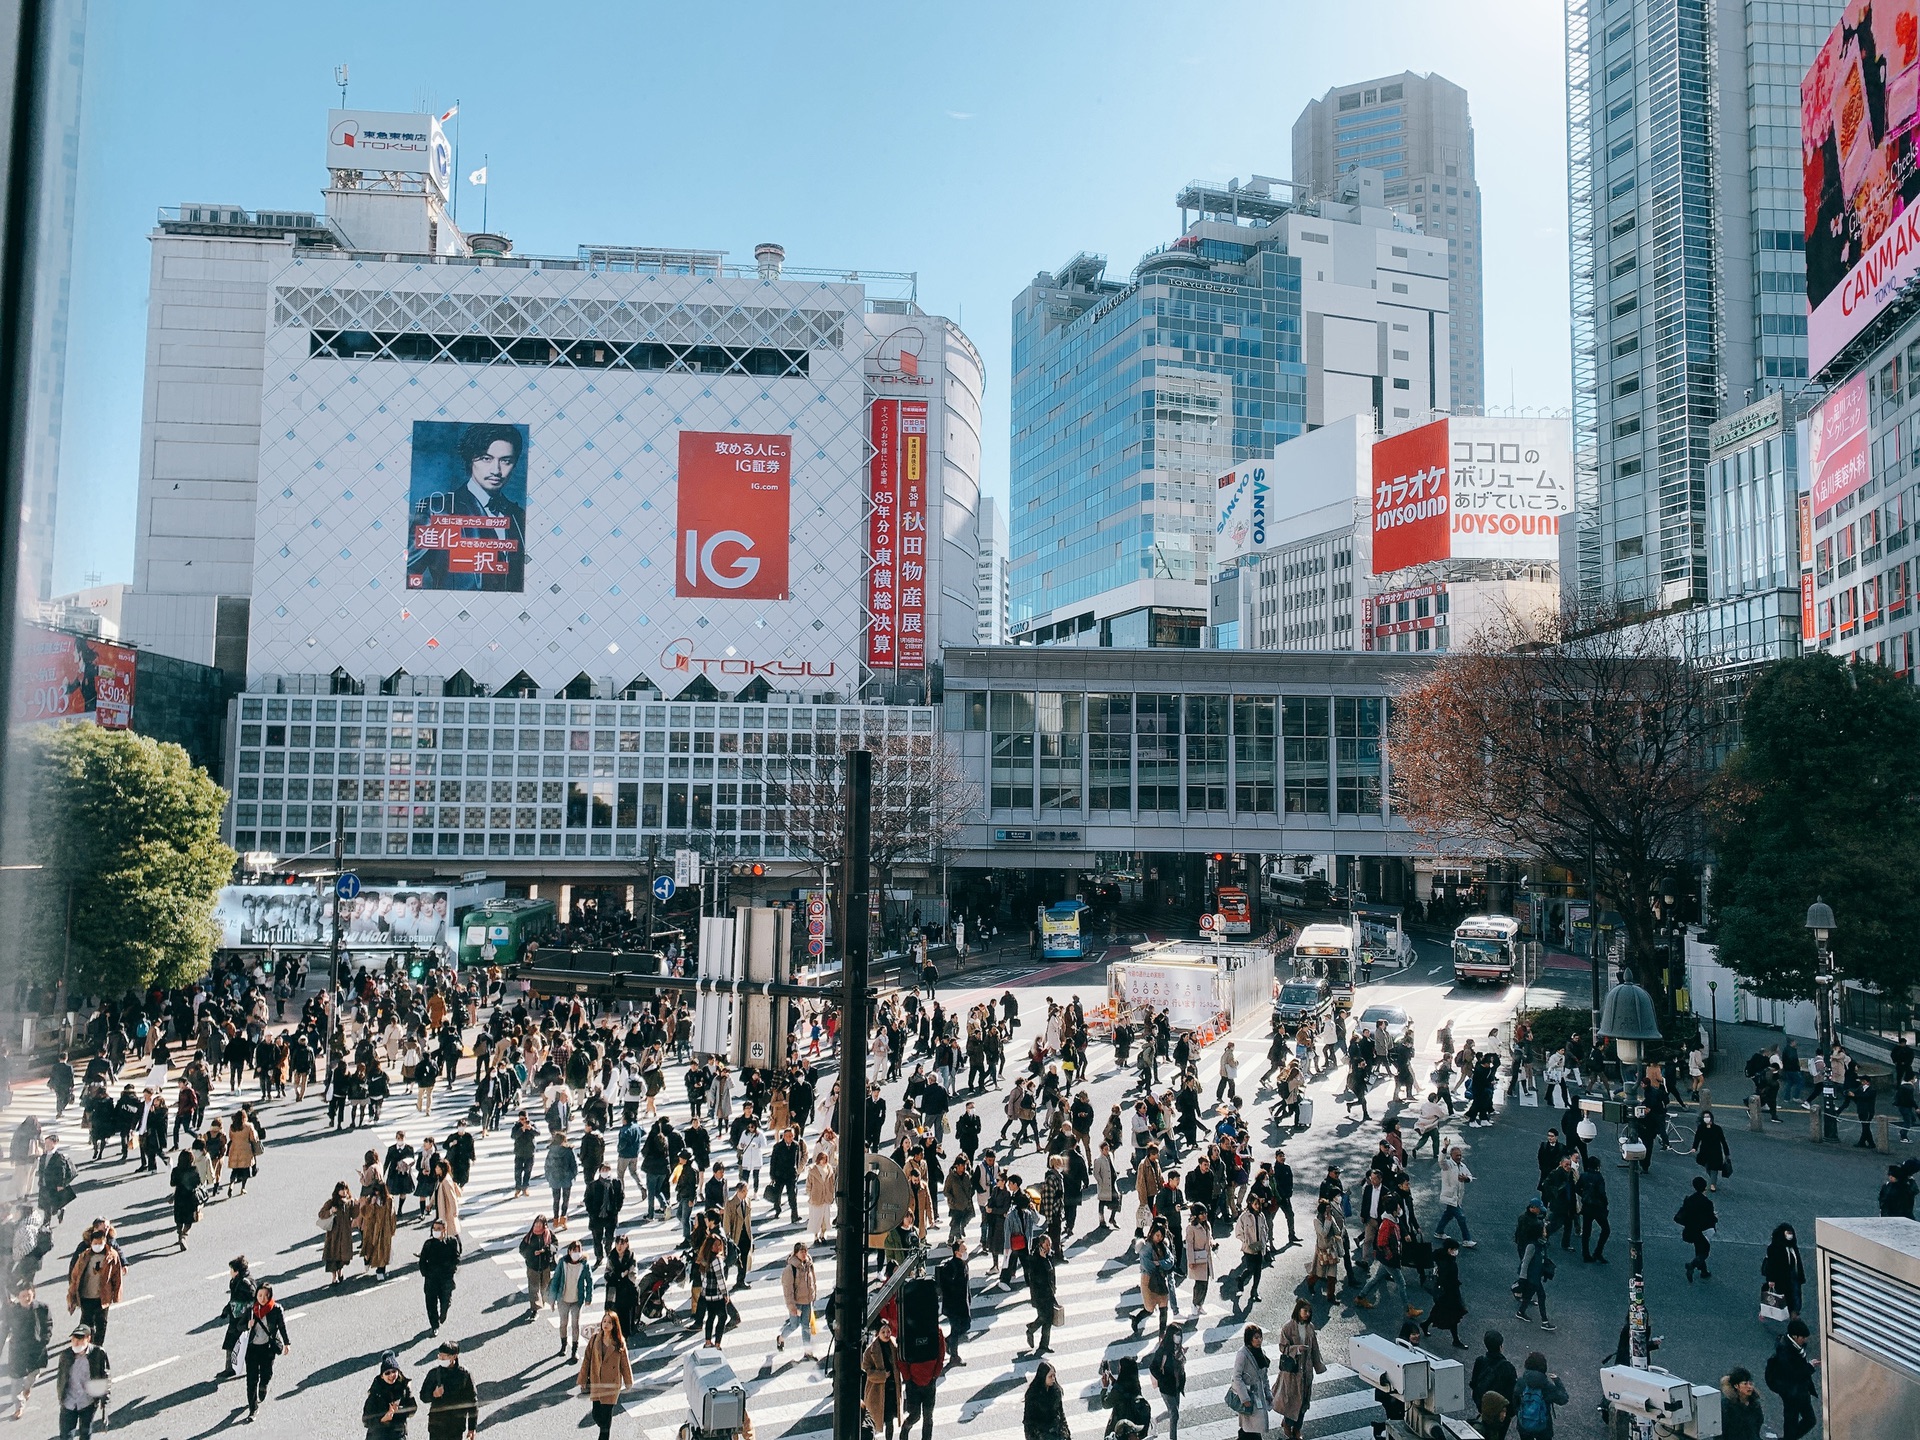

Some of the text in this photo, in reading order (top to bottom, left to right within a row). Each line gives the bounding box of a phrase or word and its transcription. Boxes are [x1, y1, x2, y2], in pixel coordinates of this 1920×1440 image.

[358, 141, 427, 151] TOKYU
[363, 131, 426, 141] 東急東横店
[1168, 278, 1239, 294] TOKYU PLAZA
[1874, 275, 1897, 306] TOKYO
[1097, 284, 1138, 319] FUKURAS
[867, 375, 933, 385] TOKYU
[1834, 386, 1864, 419] 品川スキン
[1834, 408, 1860, 440] クリニック
[715, 442, 786, 457] 攻める人に。
[1454, 442, 1539, 464] ココロの
[736, 460, 780, 473] IG証券
[1820, 451, 1865, 500] 品川美容外科
[1376, 465, 1446, 510] カラオケ
[1454, 466, 1565, 490] ボリューム、
[415, 491, 455, 514] #01
[1217, 473, 1249, 535] SANKYO
[1254, 468, 1270, 544] SANKYO
[1454, 492, 1568, 511] あげていこう。
[434, 517, 507, 526] 人生に迷ったら、自分が
[1376, 495, 1448, 532] JOYSOUND
[418, 528, 515, 549] 進化できるかどうかの、
[453, 552, 506, 572] 一択で。
[685, 530, 760, 589] IG
[410, 578, 421, 586] IG
[902, 511, 925, 633] 秋田物産展
[1379, 593, 1402, 604] カラオケ
[1403, 586, 1432, 599] JOYSOUND
[691, 659, 835, 676] TOKYU
[1608, 1391, 1620, 1400] HD
